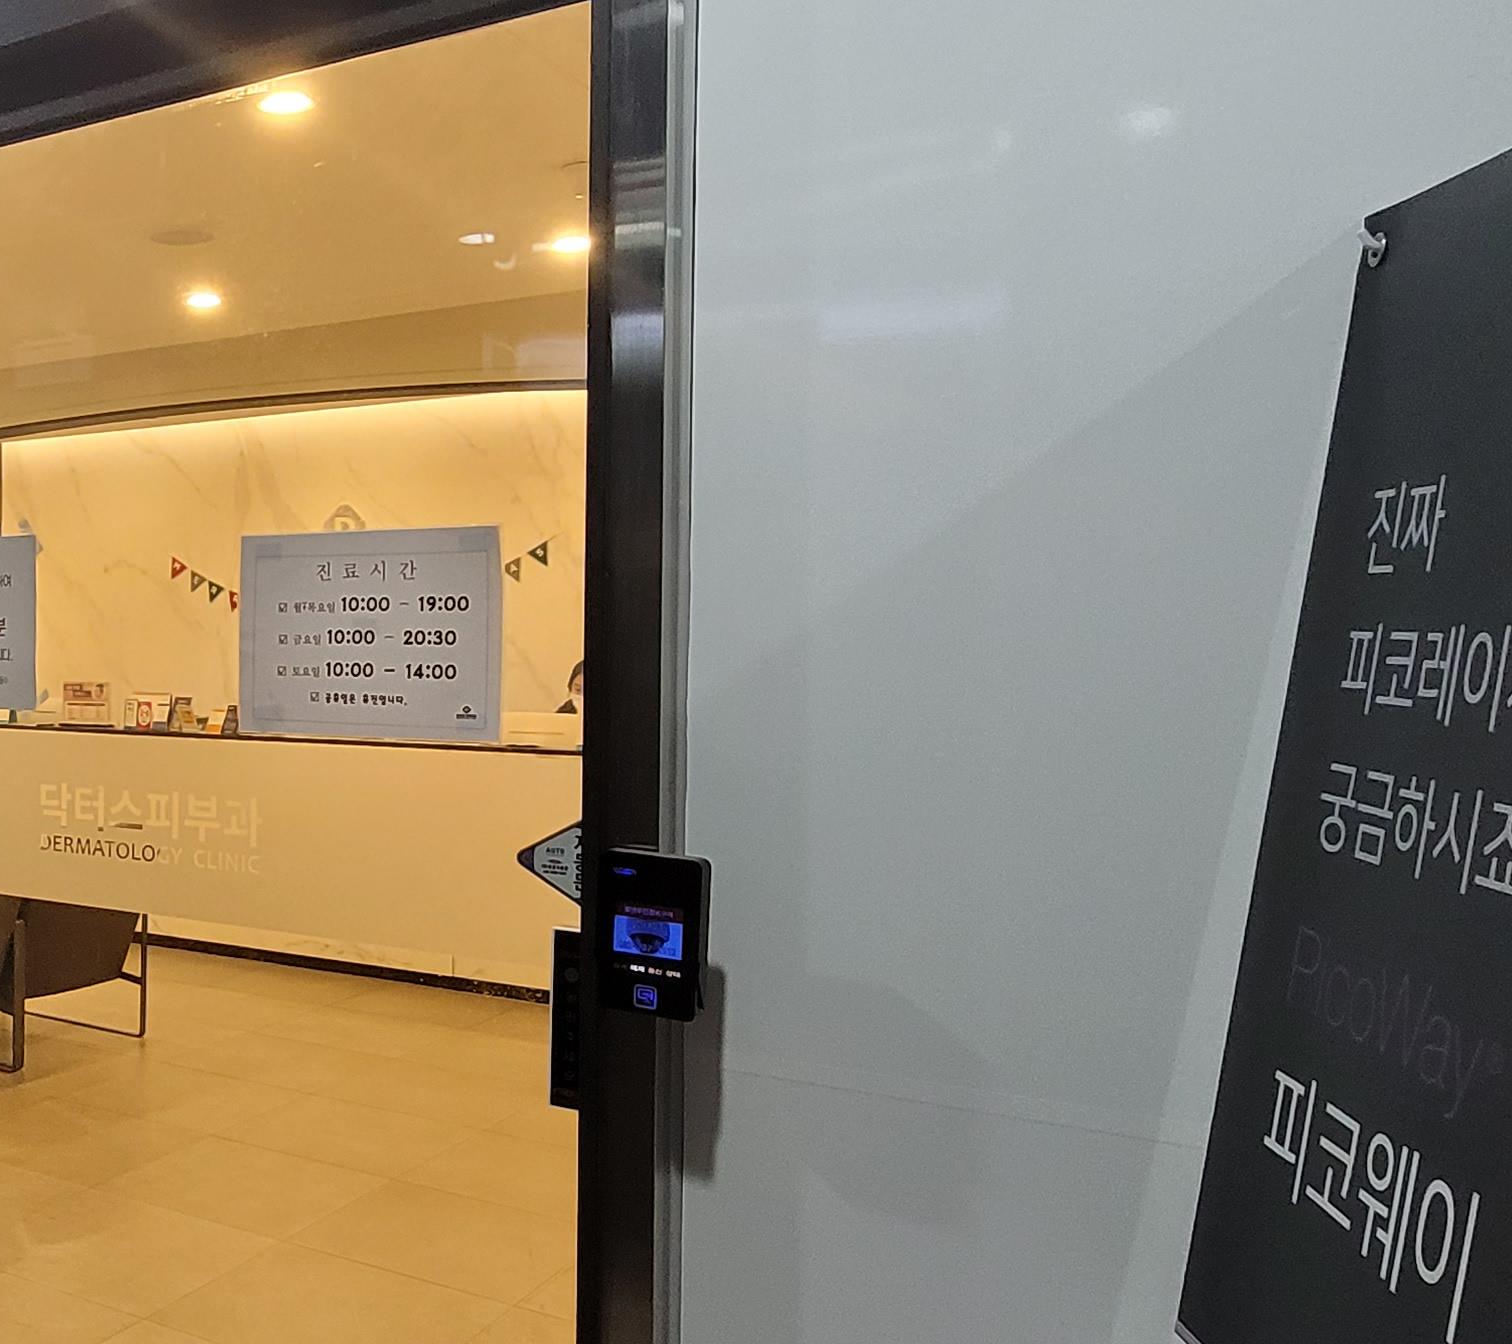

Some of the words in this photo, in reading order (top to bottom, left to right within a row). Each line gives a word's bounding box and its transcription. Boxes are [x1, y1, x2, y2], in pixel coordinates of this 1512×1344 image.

[1367, 474, 1447, 574] 진짜
[341, 596, 390, 612] 10:00
[418, 596, 470, 612] 19:00
[293, 634, 321, 645] 금요일
[327, 629, 375, 644] 10:00
[403, 630, 457, 645] 20:30
[292, 666, 320, 678] 토요일
[325, 661, 374, 677] 10:00
[405, 664, 457, 679] 14:00
[1341, 623, 1512, 733] 피코레이
[325, 692, 357, 705] 공휴일은
[39, 782, 262, 848] 닥터스피부과
[40, 834, 184, 865] DERMATOLOGY
[193, 849, 260, 874] CLINIC
